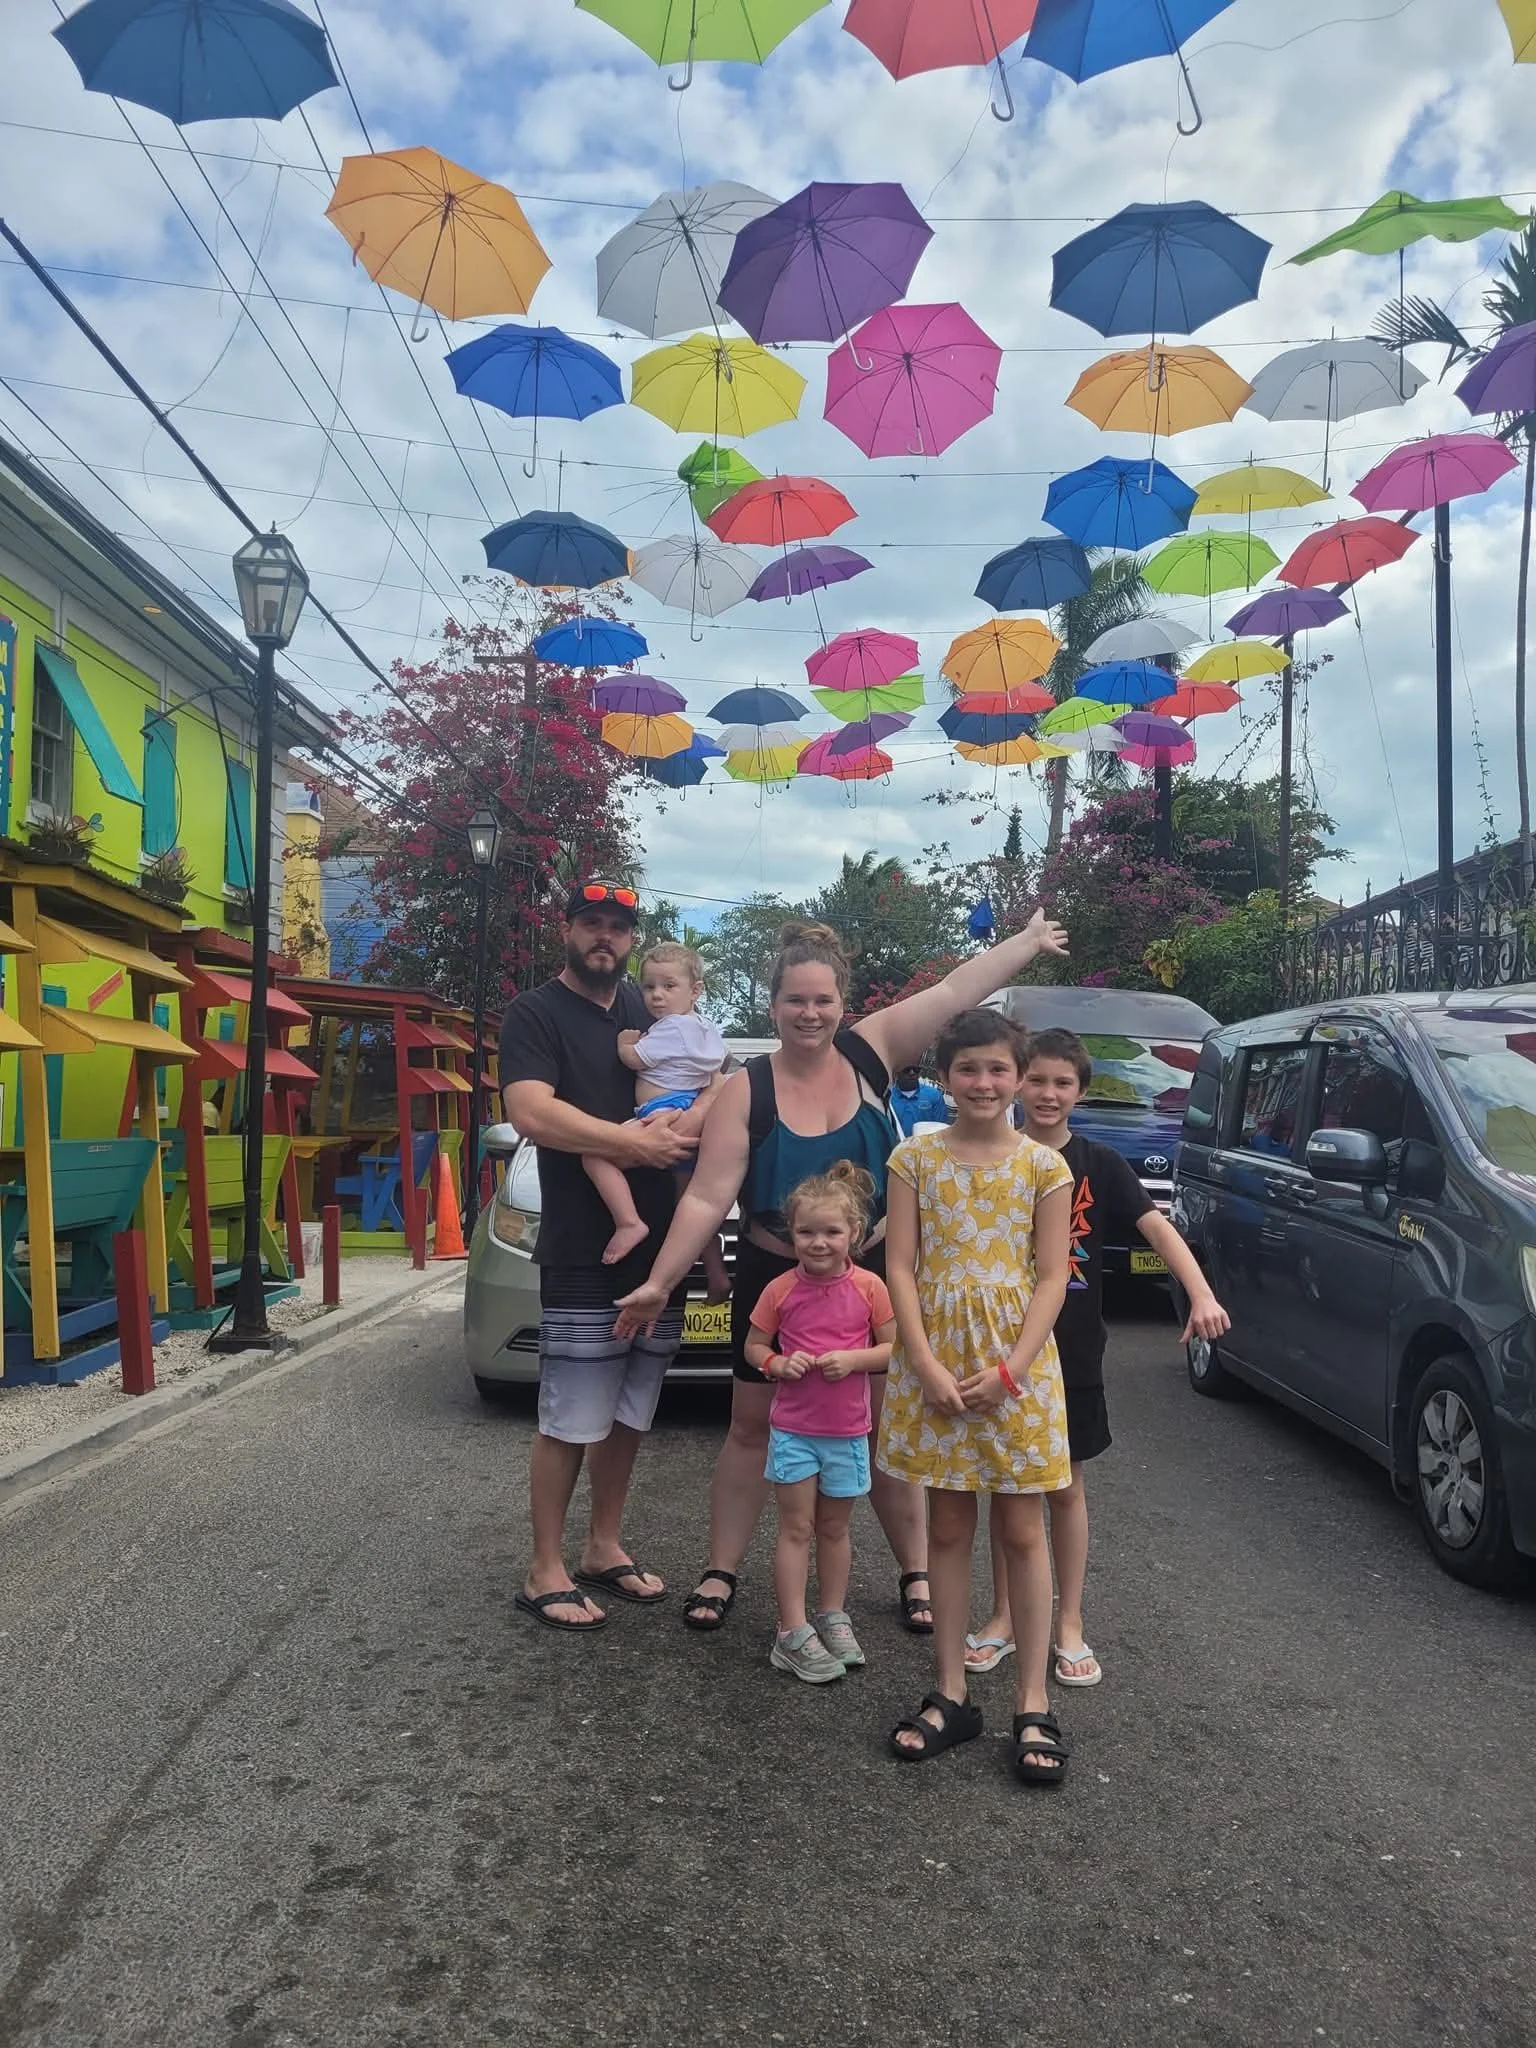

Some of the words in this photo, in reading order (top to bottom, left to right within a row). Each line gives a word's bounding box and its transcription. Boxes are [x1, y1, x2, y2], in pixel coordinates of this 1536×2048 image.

[1399, 1215, 1425, 1240] Taxi
[1136, 1255, 1165, 1268] TN05
[683, 1313, 731, 1332] N0245
